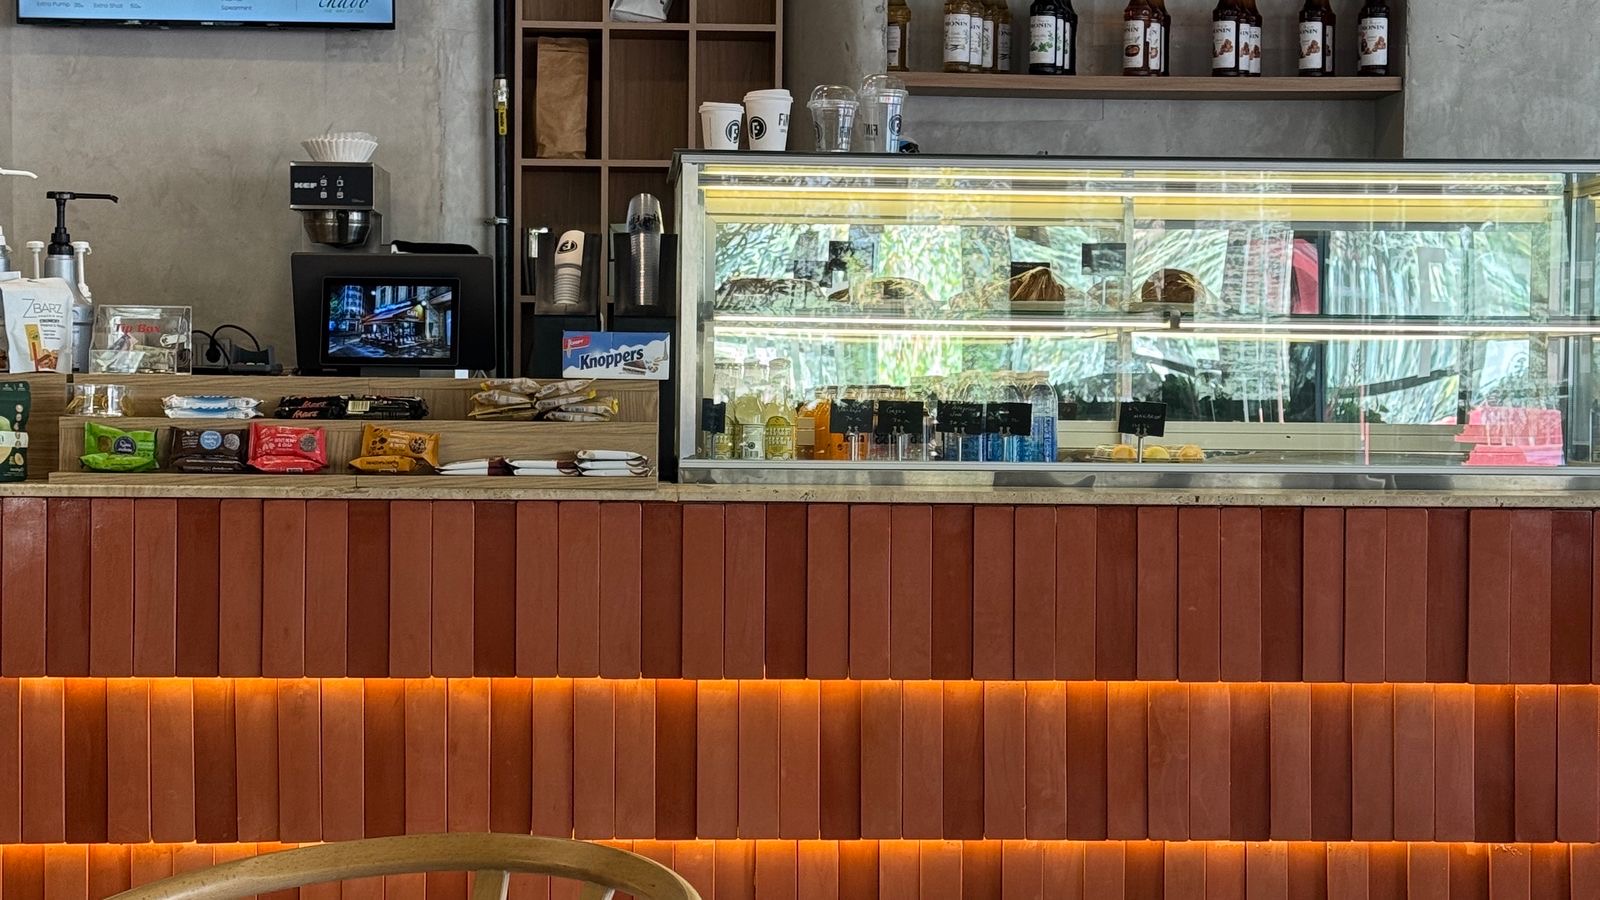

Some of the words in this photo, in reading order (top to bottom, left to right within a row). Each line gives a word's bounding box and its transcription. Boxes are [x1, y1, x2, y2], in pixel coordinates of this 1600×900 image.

[114, 323, 133, 335] Tip
[137, 323, 160, 333] Box
[580, 348, 644, 371] Knoppers
